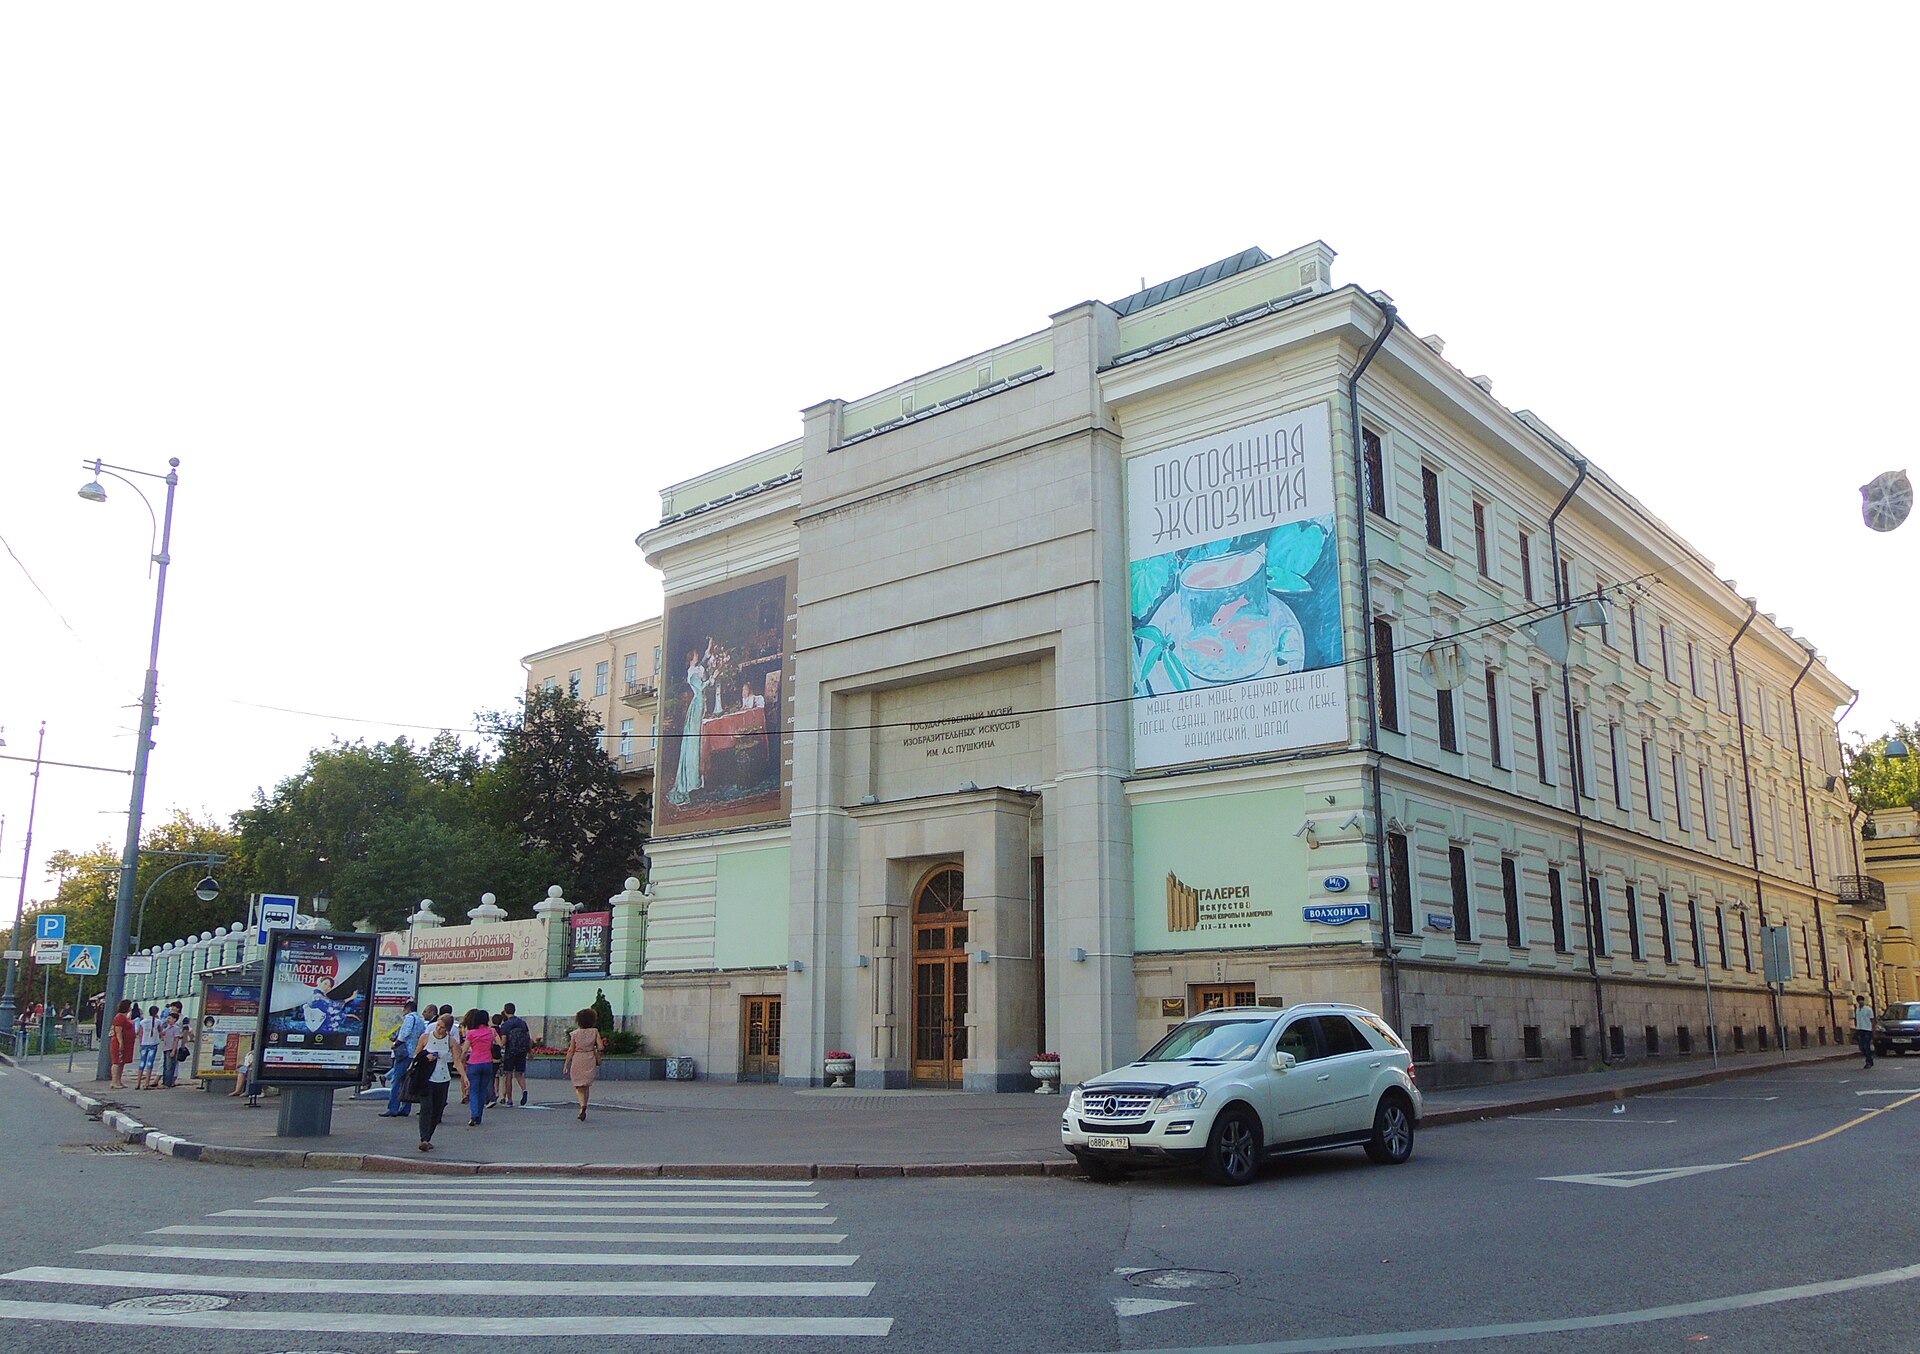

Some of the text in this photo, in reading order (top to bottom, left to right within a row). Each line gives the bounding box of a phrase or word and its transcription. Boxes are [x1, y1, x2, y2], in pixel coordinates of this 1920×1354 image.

[1154, 423, 1305, 502] ПОСТОЯННАЯ
[1152, 467, 1307, 544] ЭКСПОЗИЦИЯ
[1285, 677, 1305, 694] ВАН
[986, 706, 1013, 717] МУЗЕЙ
[903, 720, 1021, 747] ИЗОБРАЗИТЕЛЬНЫХ ИСКУССТВ
[1254, 720, 1289, 738] ШАГАЛ
[955, 740, 995, 753] ПУШКИНА
[1199, 886, 1250, 900] ГАЛЕРЕЯ
[1246, 910, 1273, 918] АМЕРИКИ
[1310, 907, 1360, 918] ВОЛХОНКА
[576, 926, 602, 939] ВЕЧЕР
[412, 931, 511, 949] Реклама и обложка
[334, 944, 366, 952] СЕНТЯБРЯ
[468, 947, 511, 960] журналов
[279, 963, 332, 974] СПАССКАЯ
[278, 973, 315, 984] БАШНЯ
